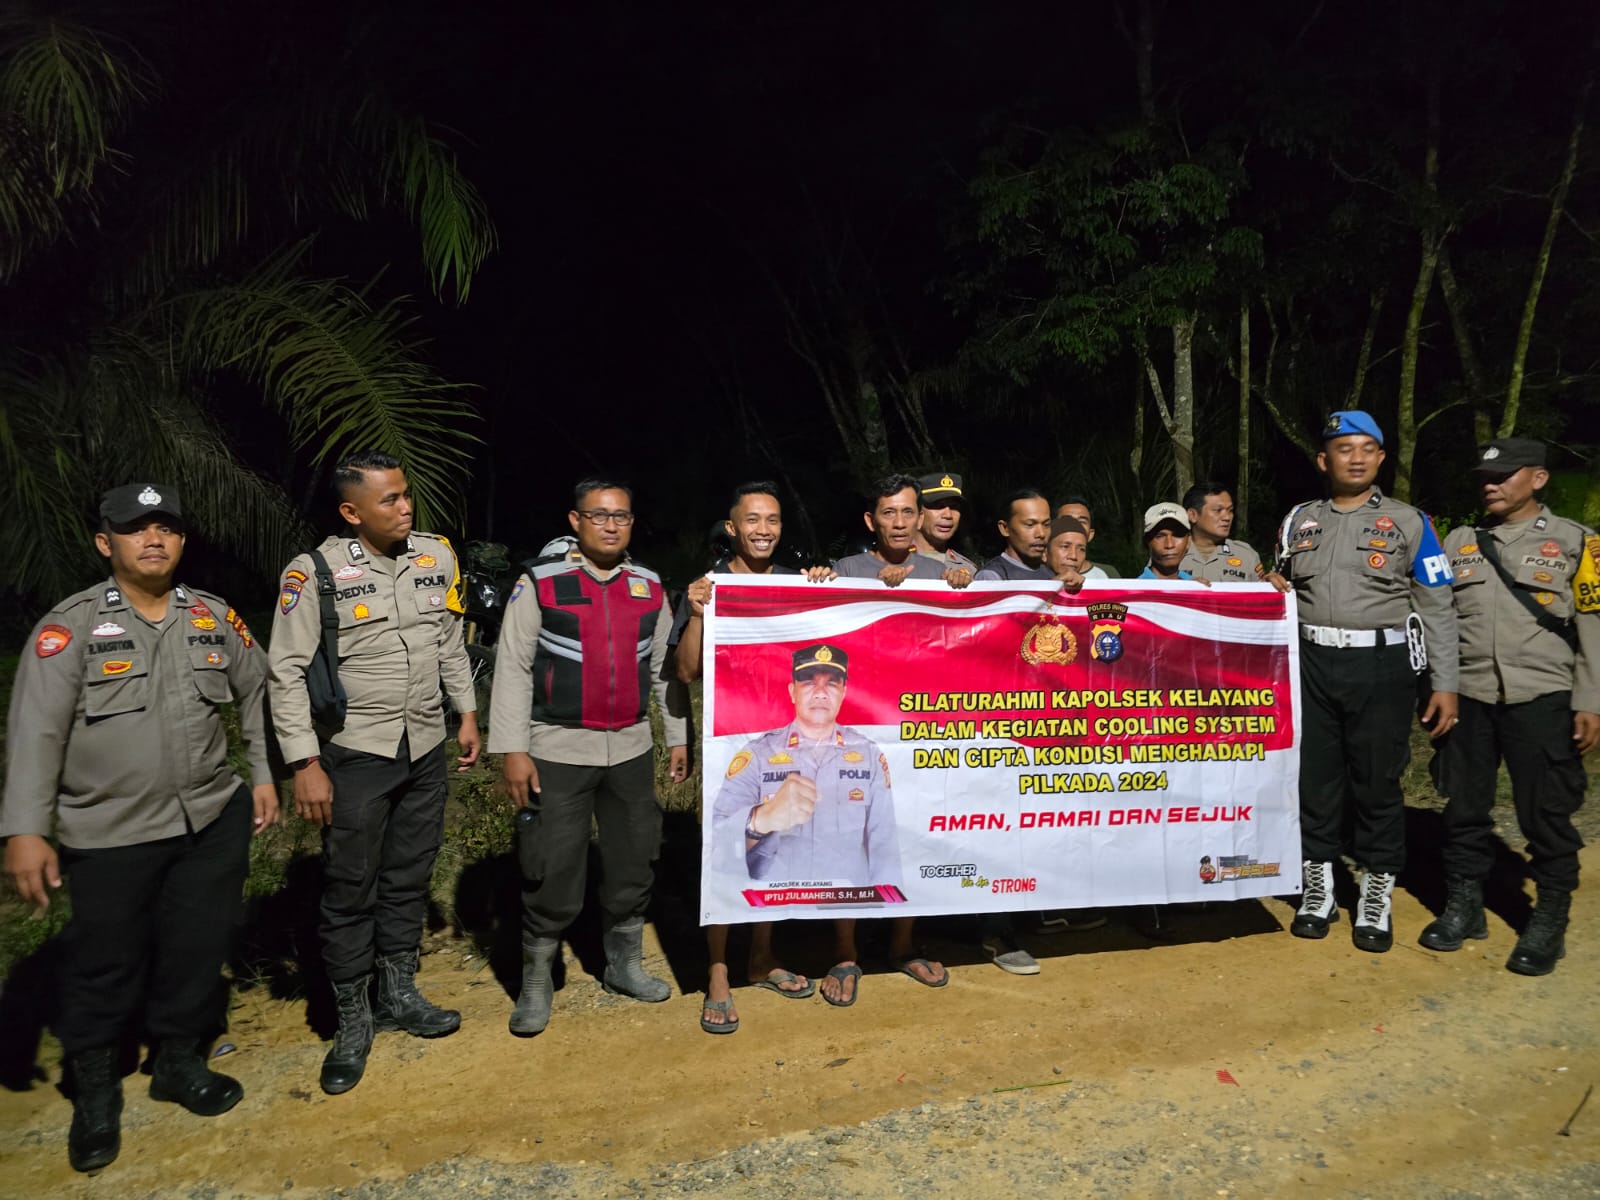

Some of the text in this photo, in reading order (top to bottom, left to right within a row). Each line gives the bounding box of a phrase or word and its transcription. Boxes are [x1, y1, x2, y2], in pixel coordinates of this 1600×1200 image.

[1293, 528, 1323, 541] EVAN
[1363, 527, 1401, 539] POLRI
[1525, 557, 1566, 570] POLRI
[1087, 603, 1111, 613] POLRES
[900, 688, 1274, 712] SILATURAHMI KAPOLSEK KELAYANG
[900, 715, 1276, 741] DALAM KEGIATAN COOLING SYSTEM
[914, 743, 1265, 768] DAN CIPTA KONDISI MENGHADAPI
[839, 769, 871, 780] POLRI
[1019, 772, 1168, 795] PILKADA 2024
[929, 805, 1253, 832] AMAN, DAMAI DAN SEJUK
[920, 864, 977, 878] TOGETHER
[991, 878, 1037, 894] STRONG
[764, 892, 784, 902] IPTU
